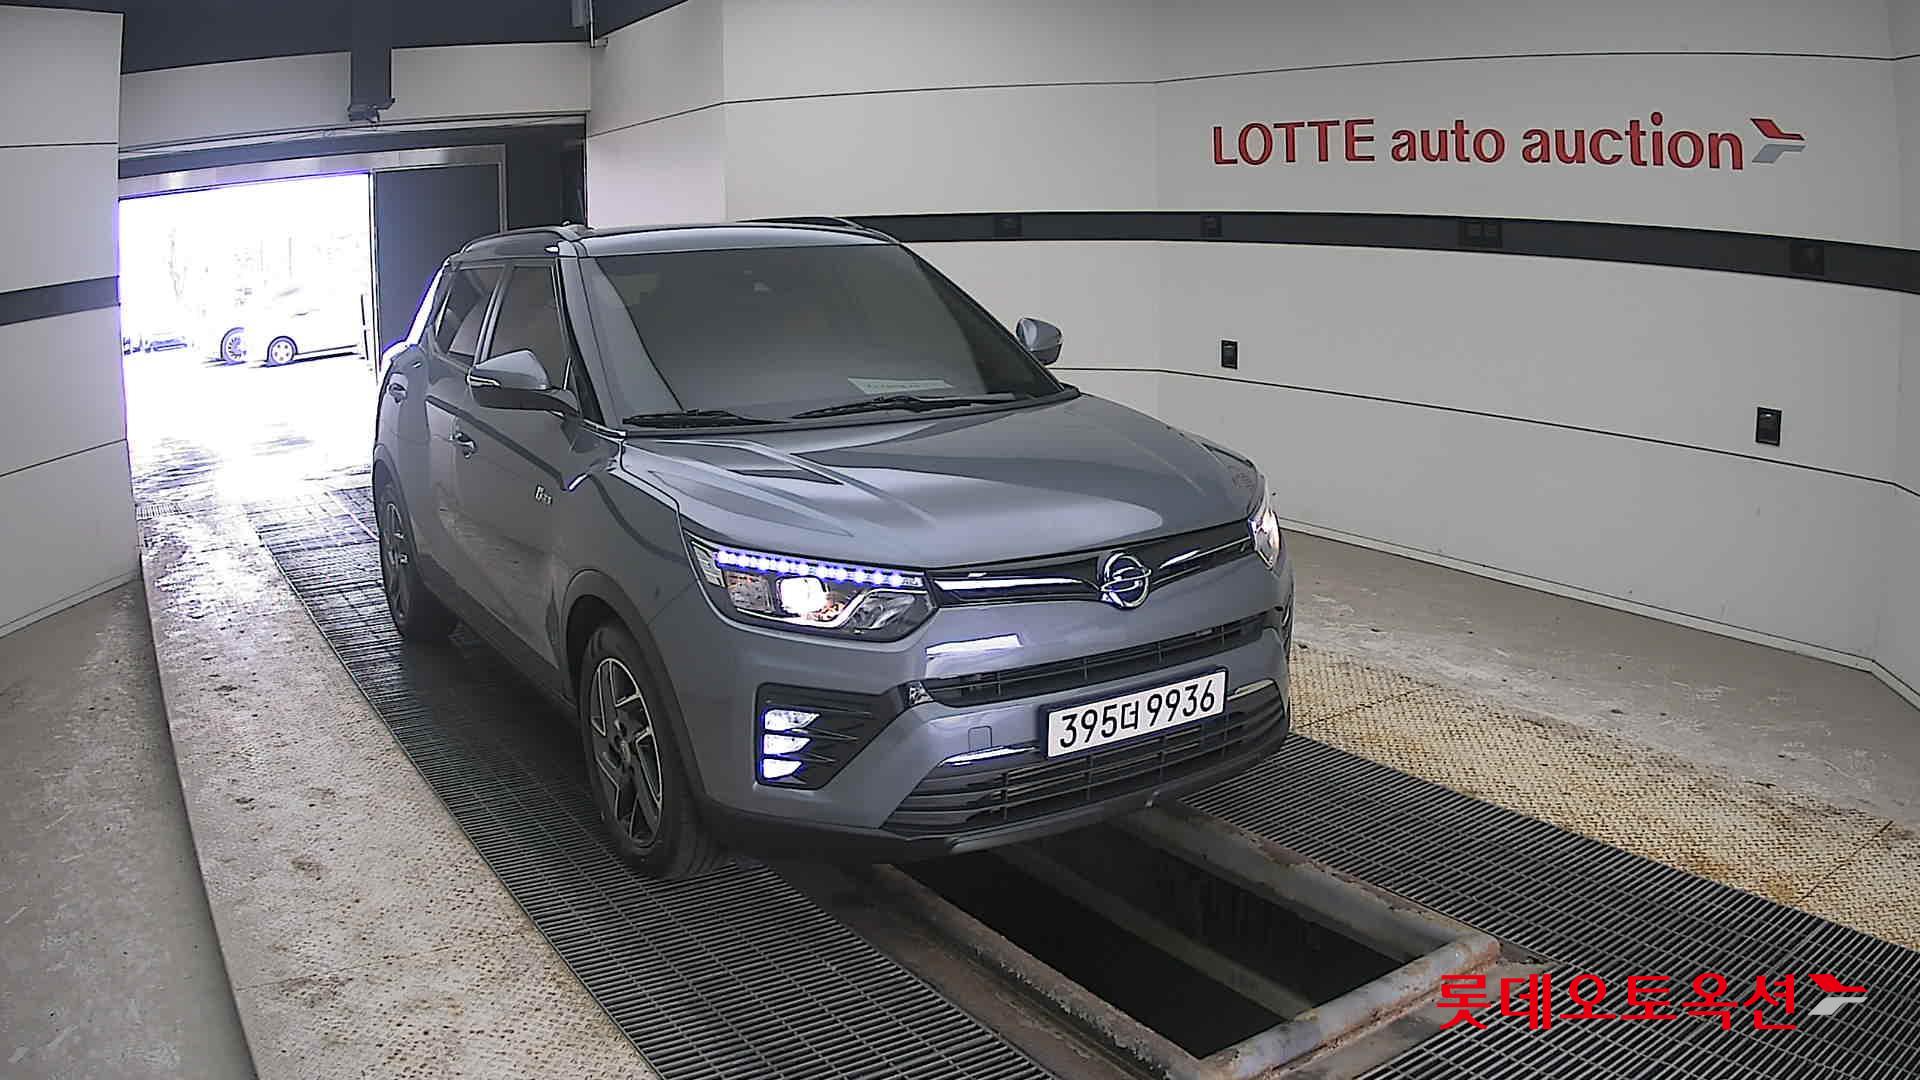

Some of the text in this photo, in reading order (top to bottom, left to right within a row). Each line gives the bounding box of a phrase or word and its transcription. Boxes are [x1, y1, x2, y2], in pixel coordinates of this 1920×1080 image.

[1213, 112, 1744, 170] LOTTE auto auction
[1060, 679, 1215, 748] 395더 9936
